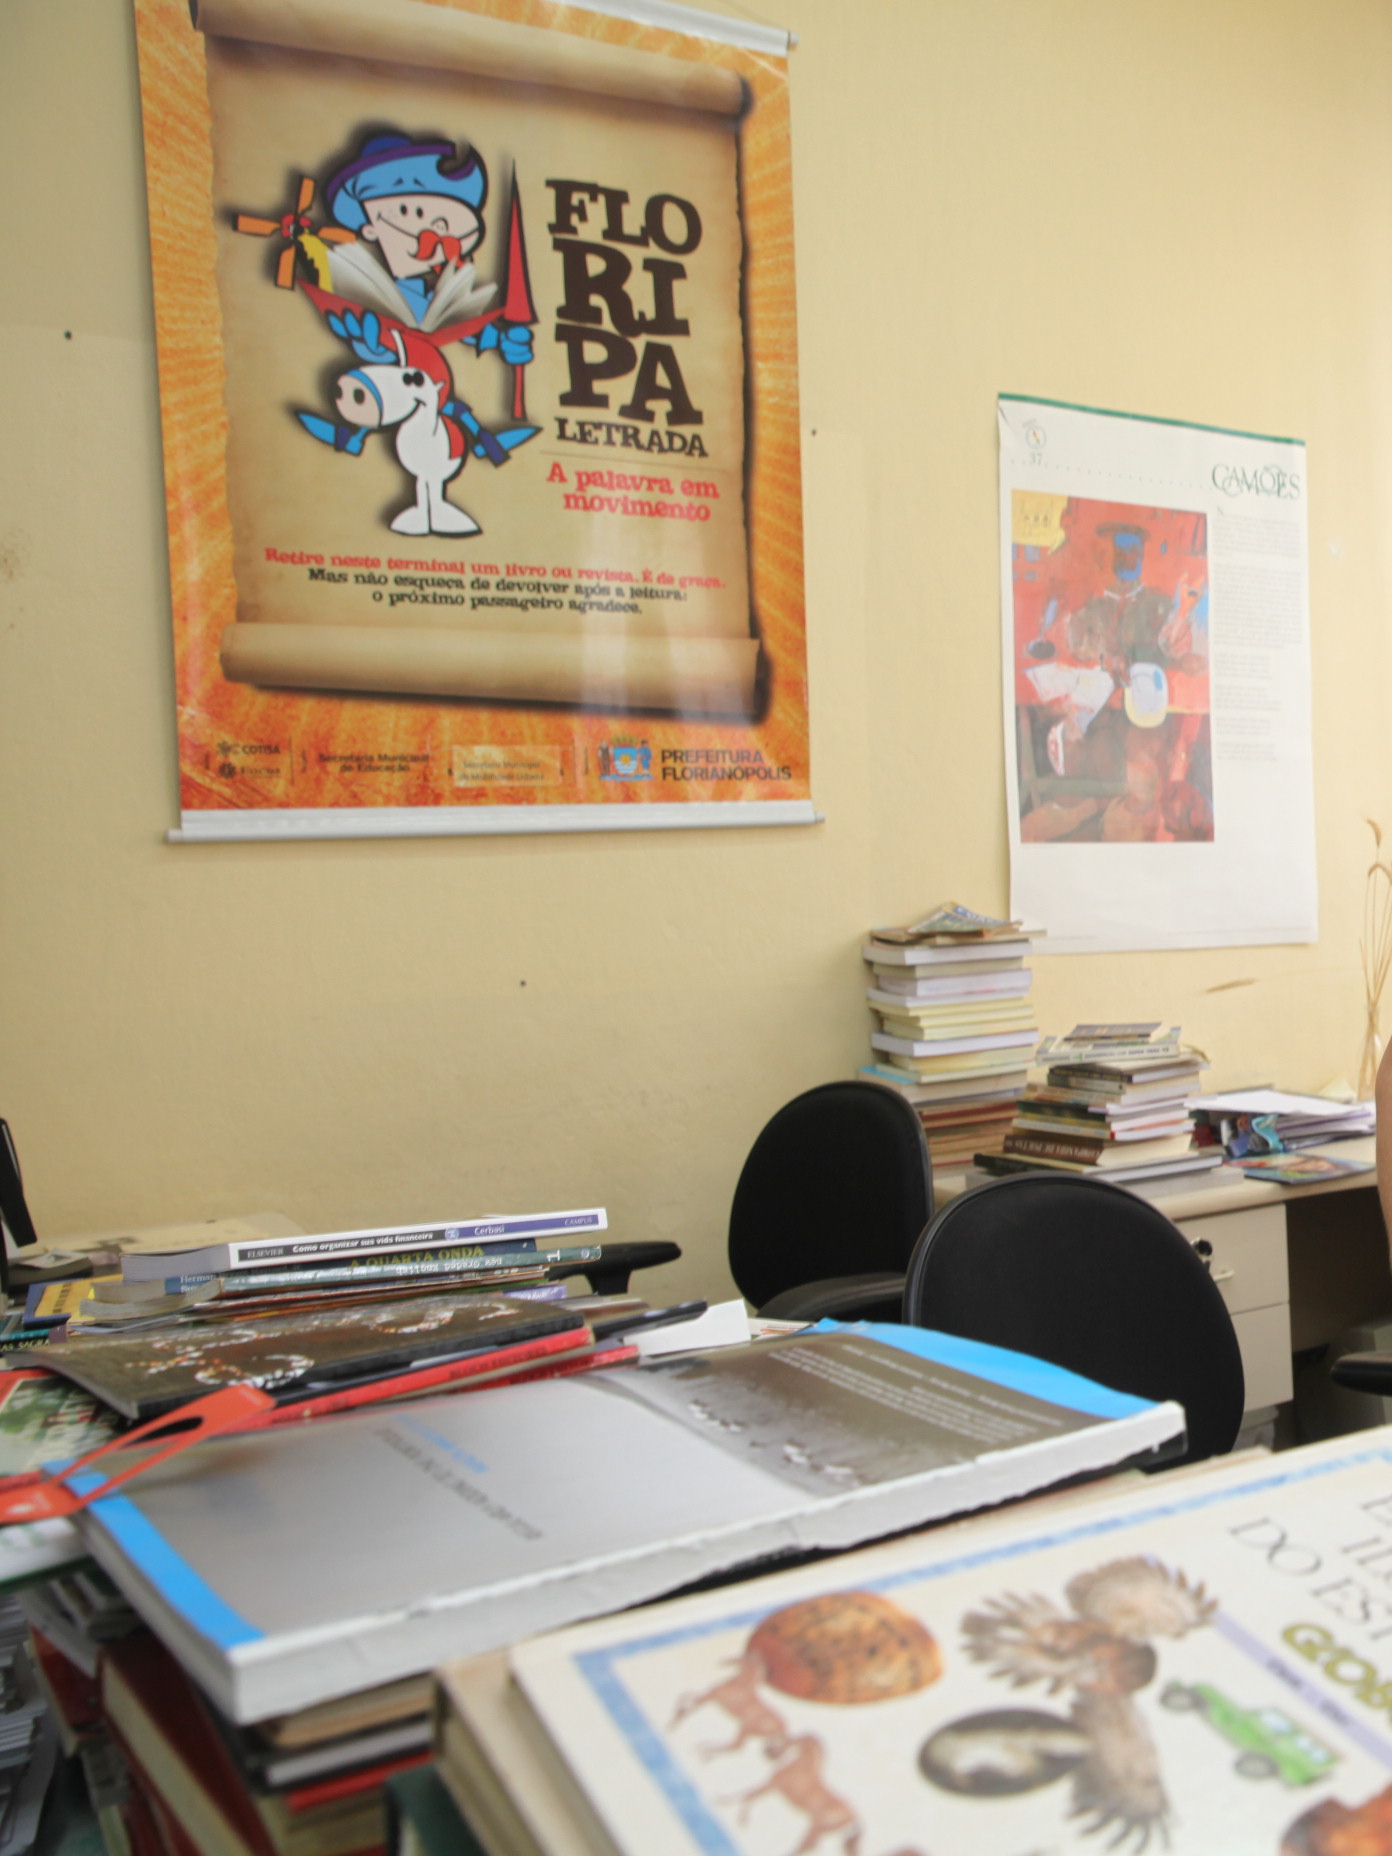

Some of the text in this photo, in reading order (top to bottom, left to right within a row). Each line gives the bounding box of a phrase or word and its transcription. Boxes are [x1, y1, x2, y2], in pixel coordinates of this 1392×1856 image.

[545, 178, 703, 256] FLO
[551, 236, 691, 338] RI
[554, 322, 704, 426] PA
[554, 417, 709, 459] LETRADA
[546, 462, 720, 499] A palavra em
[1211, 462, 1302, 502] CAMÕES
[562, 491, 711, 522] movimento
[264, 547, 325, 566] Retire
[330, 555, 382, 569] neste
[386, 555, 466, 575] terminal
[470, 561, 501, 576] um
[505, 562, 548, 578] livro
[551, 564, 573, 579] ou
[656, 570, 676, 585] de
[307, 567, 349, 584] Mas
[353, 571, 389, 586] não
[393, 575, 466, 592] esqueça
[469, 576, 491, 591] de
[495, 577, 571, 594] devolver
[573, 581, 611, 601] após
[615, 586, 625, 598] a
[371, 590, 384, 602] o
[387, 589, 465, 608] próximo
[469, 595, 565, 613] passageiro
[318, 753, 375, 764] Secretaria
[377, 752, 430, 765] Municipal
[339, 762, 411, 775] de Educação
[660, 747, 765, 765] PREFEITURA
[661, 763, 792, 782] FLORIANÓPOLIS
[247, 1247, 284, 1259] ELSEVIER
[292, 1244, 318, 1254] Como
[319, 1240, 360, 1252] organizar
[376, 1236, 394, 1245] vida
[394, 1232, 434, 1244] financeira
[564, 1216, 592, 1226] CAMPUS
[365, 1251, 434, 1267] QUARTA
[438, 1245, 485, 1260] ONDA
[1228, 1515, 1323, 1578] DO
